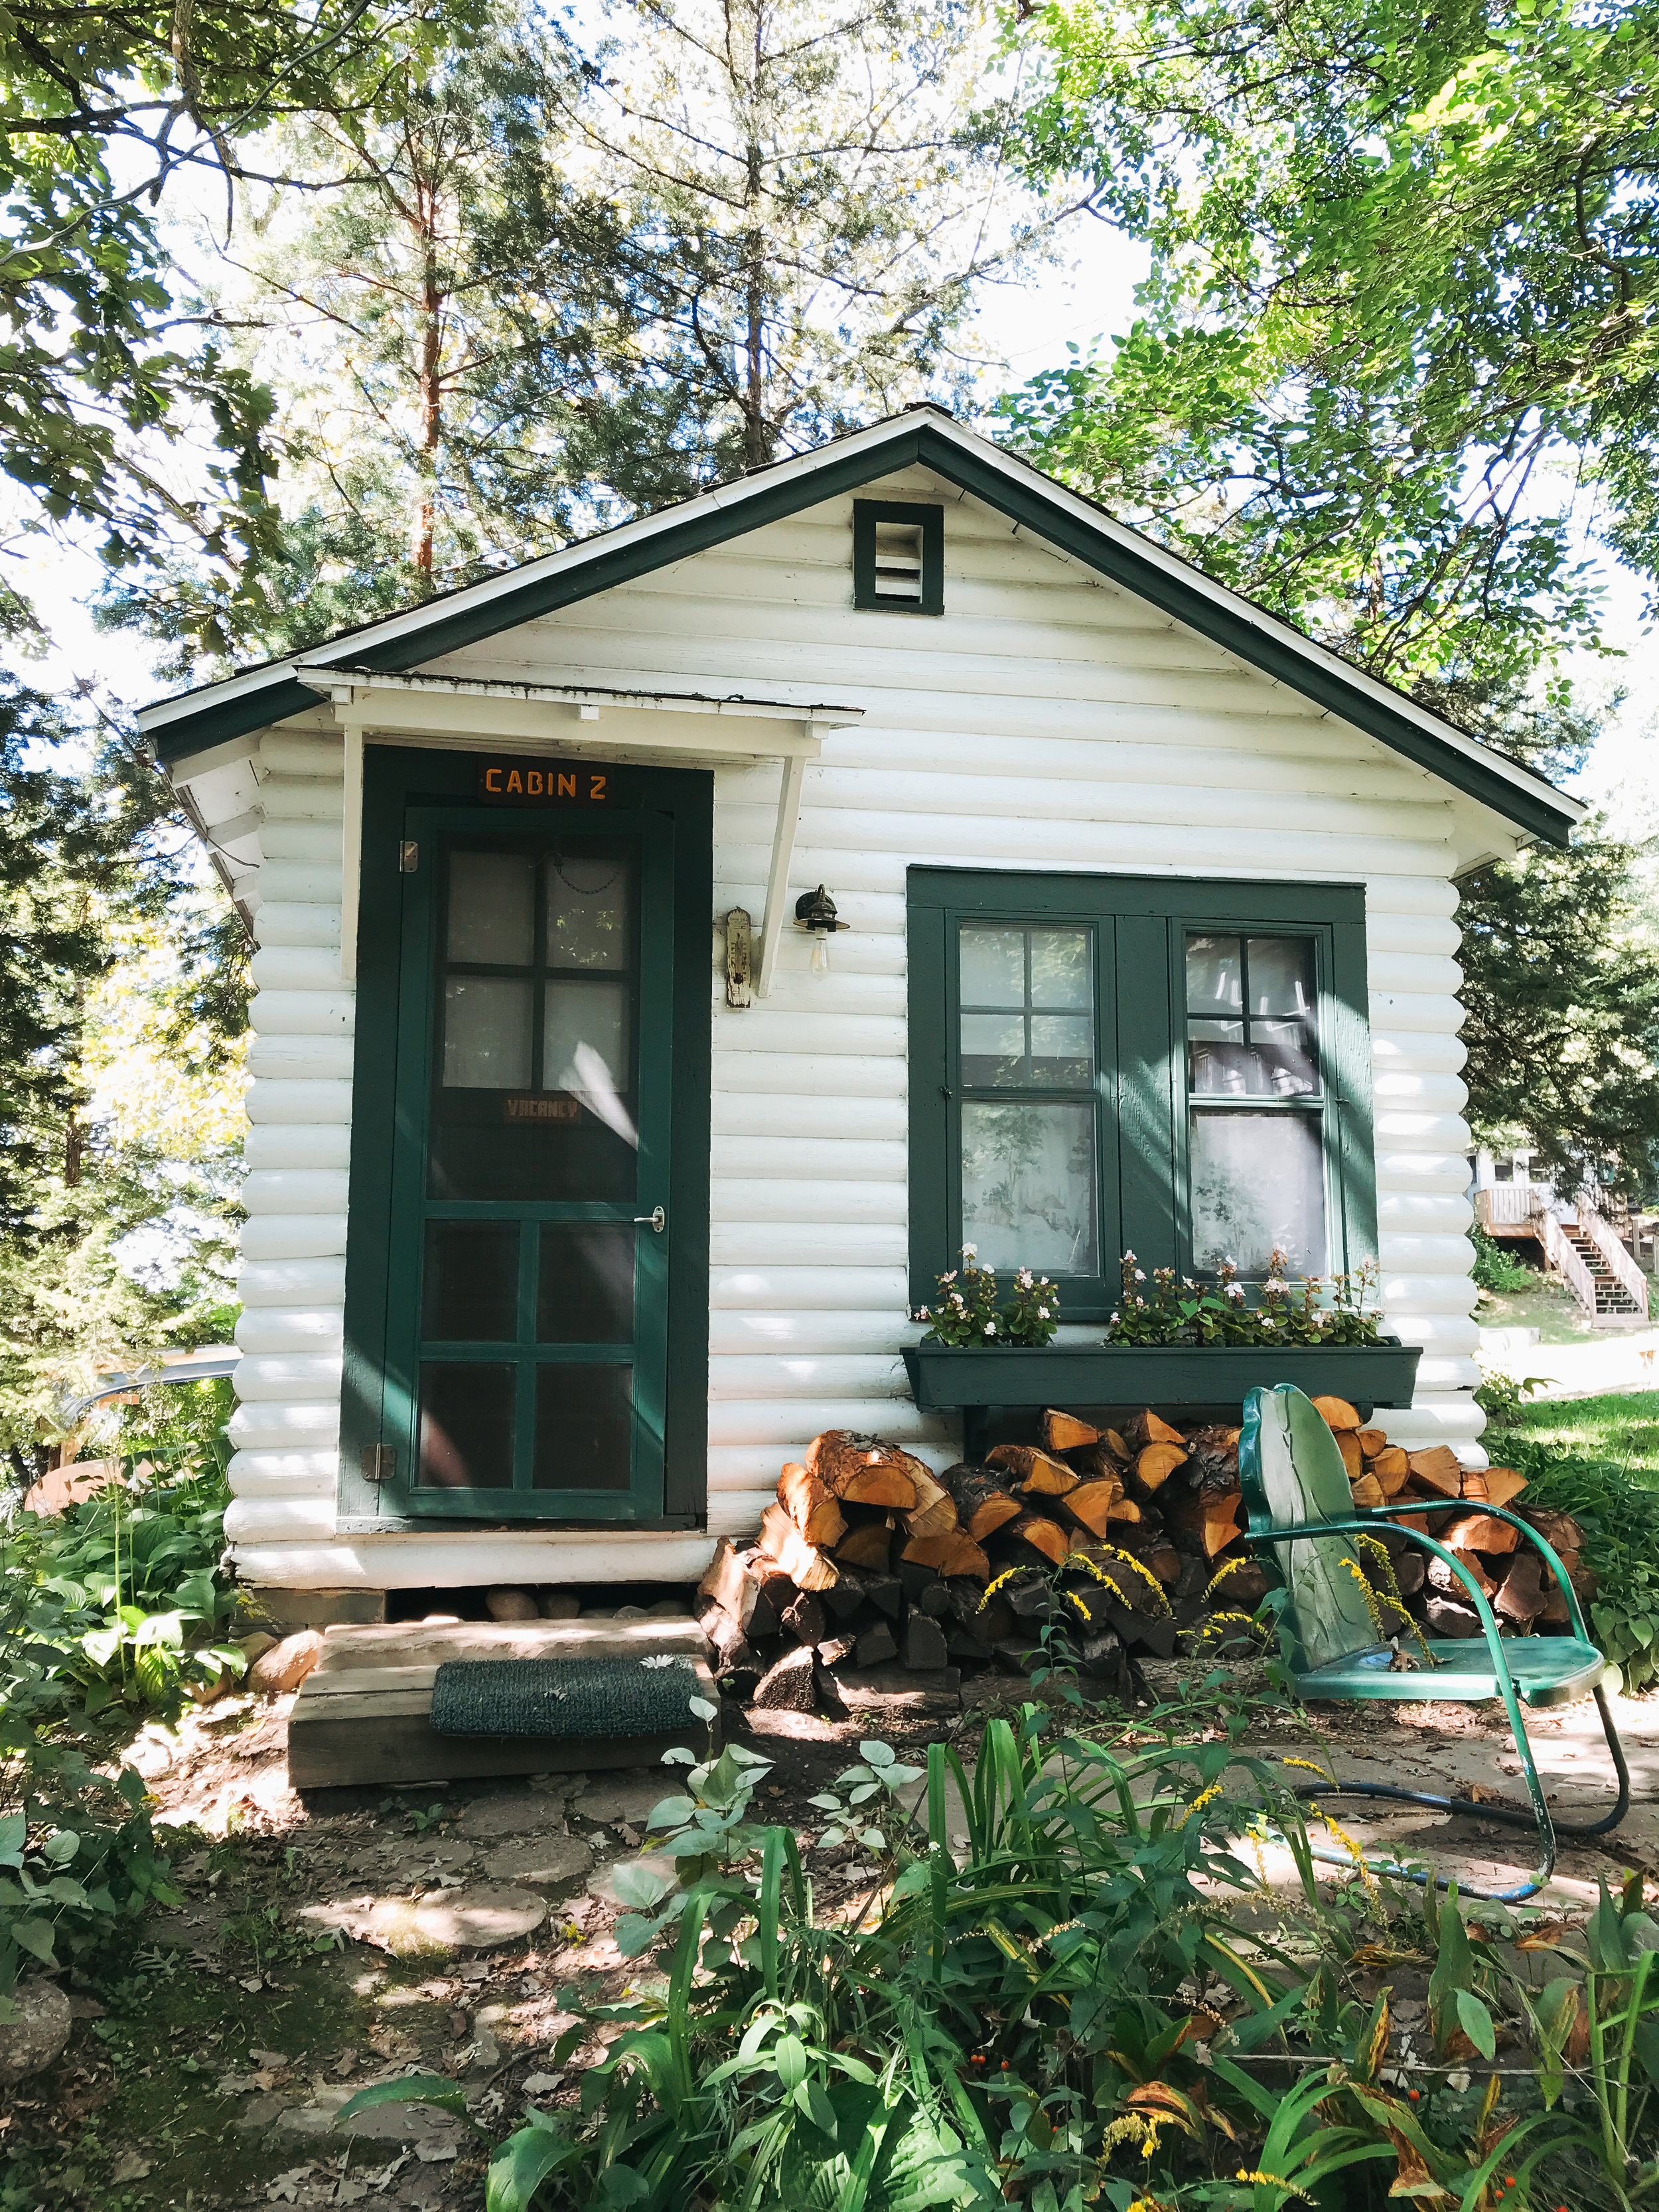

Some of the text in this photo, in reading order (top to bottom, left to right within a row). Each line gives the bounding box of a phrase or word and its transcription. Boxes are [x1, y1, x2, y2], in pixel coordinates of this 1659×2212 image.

[486, 769, 607, 800] CABIN 2
[507, 1099, 578, 1118] VACANCY
